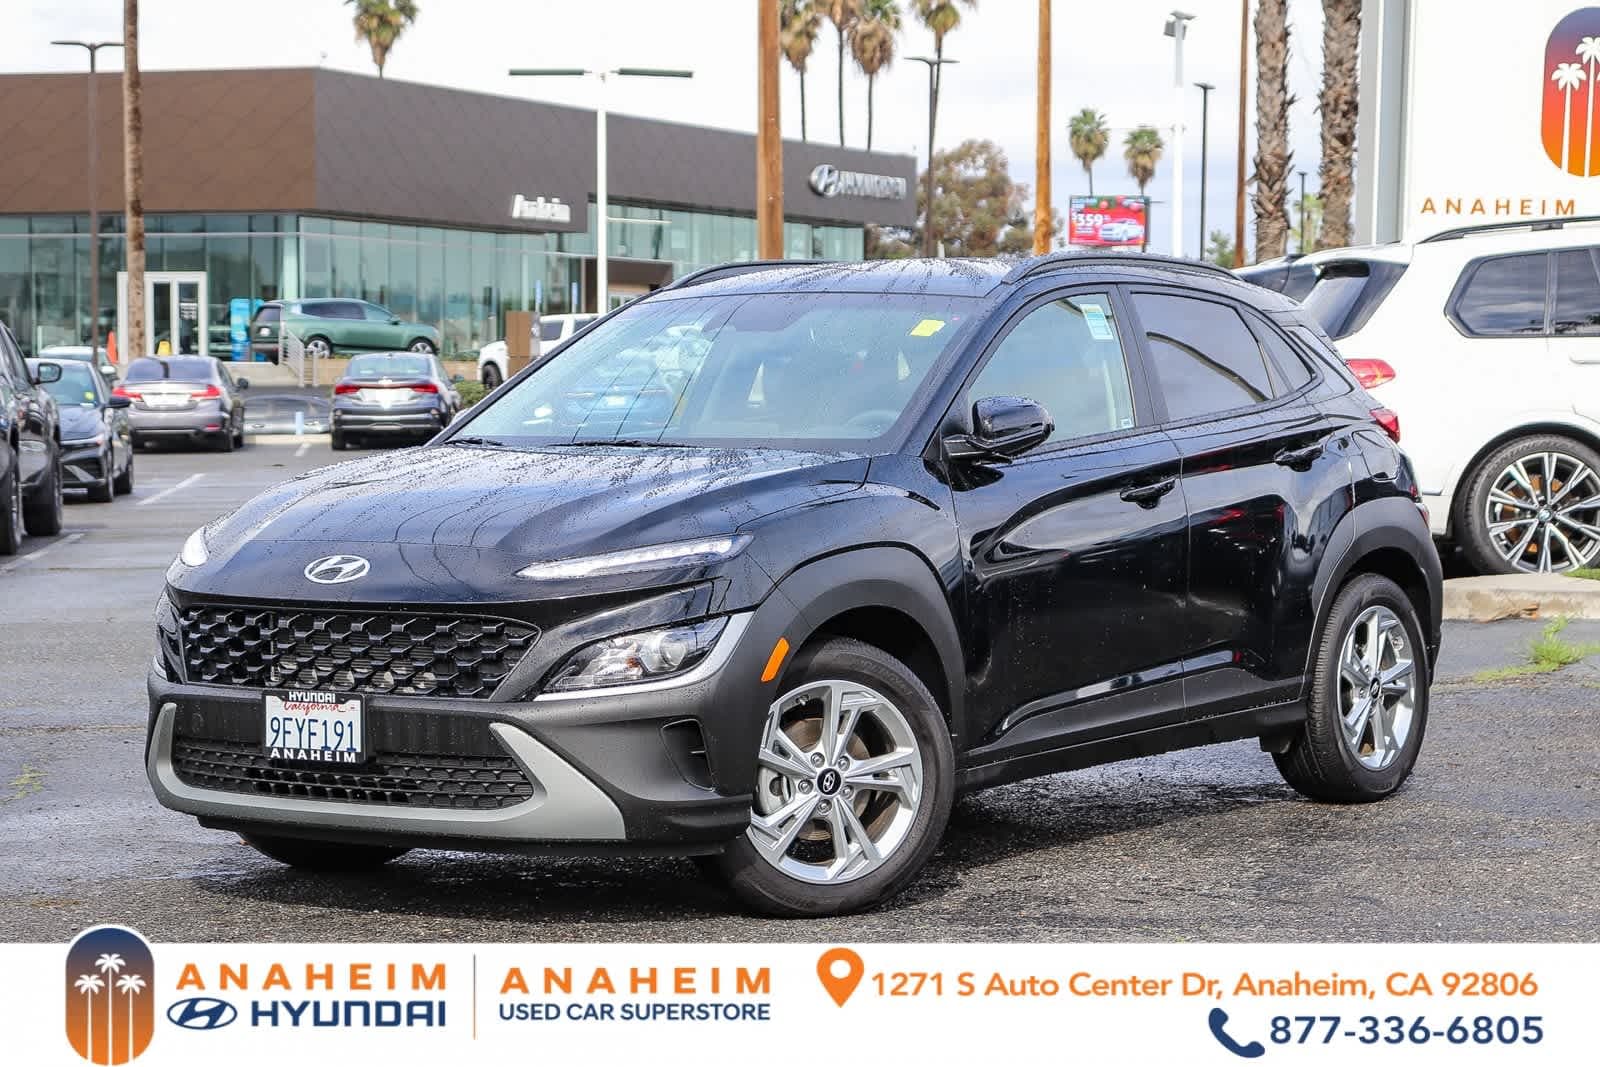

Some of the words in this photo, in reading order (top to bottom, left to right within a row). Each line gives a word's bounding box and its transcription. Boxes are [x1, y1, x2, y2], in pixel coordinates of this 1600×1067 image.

[1420, 197, 1576, 216] ANAHEIM
[288, 691, 336, 703] HYUNDAI
[283, 700, 341, 716] California
[269, 716, 357, 753] 9FYF191
[269, 747, 356, 763] ANAHEIM
